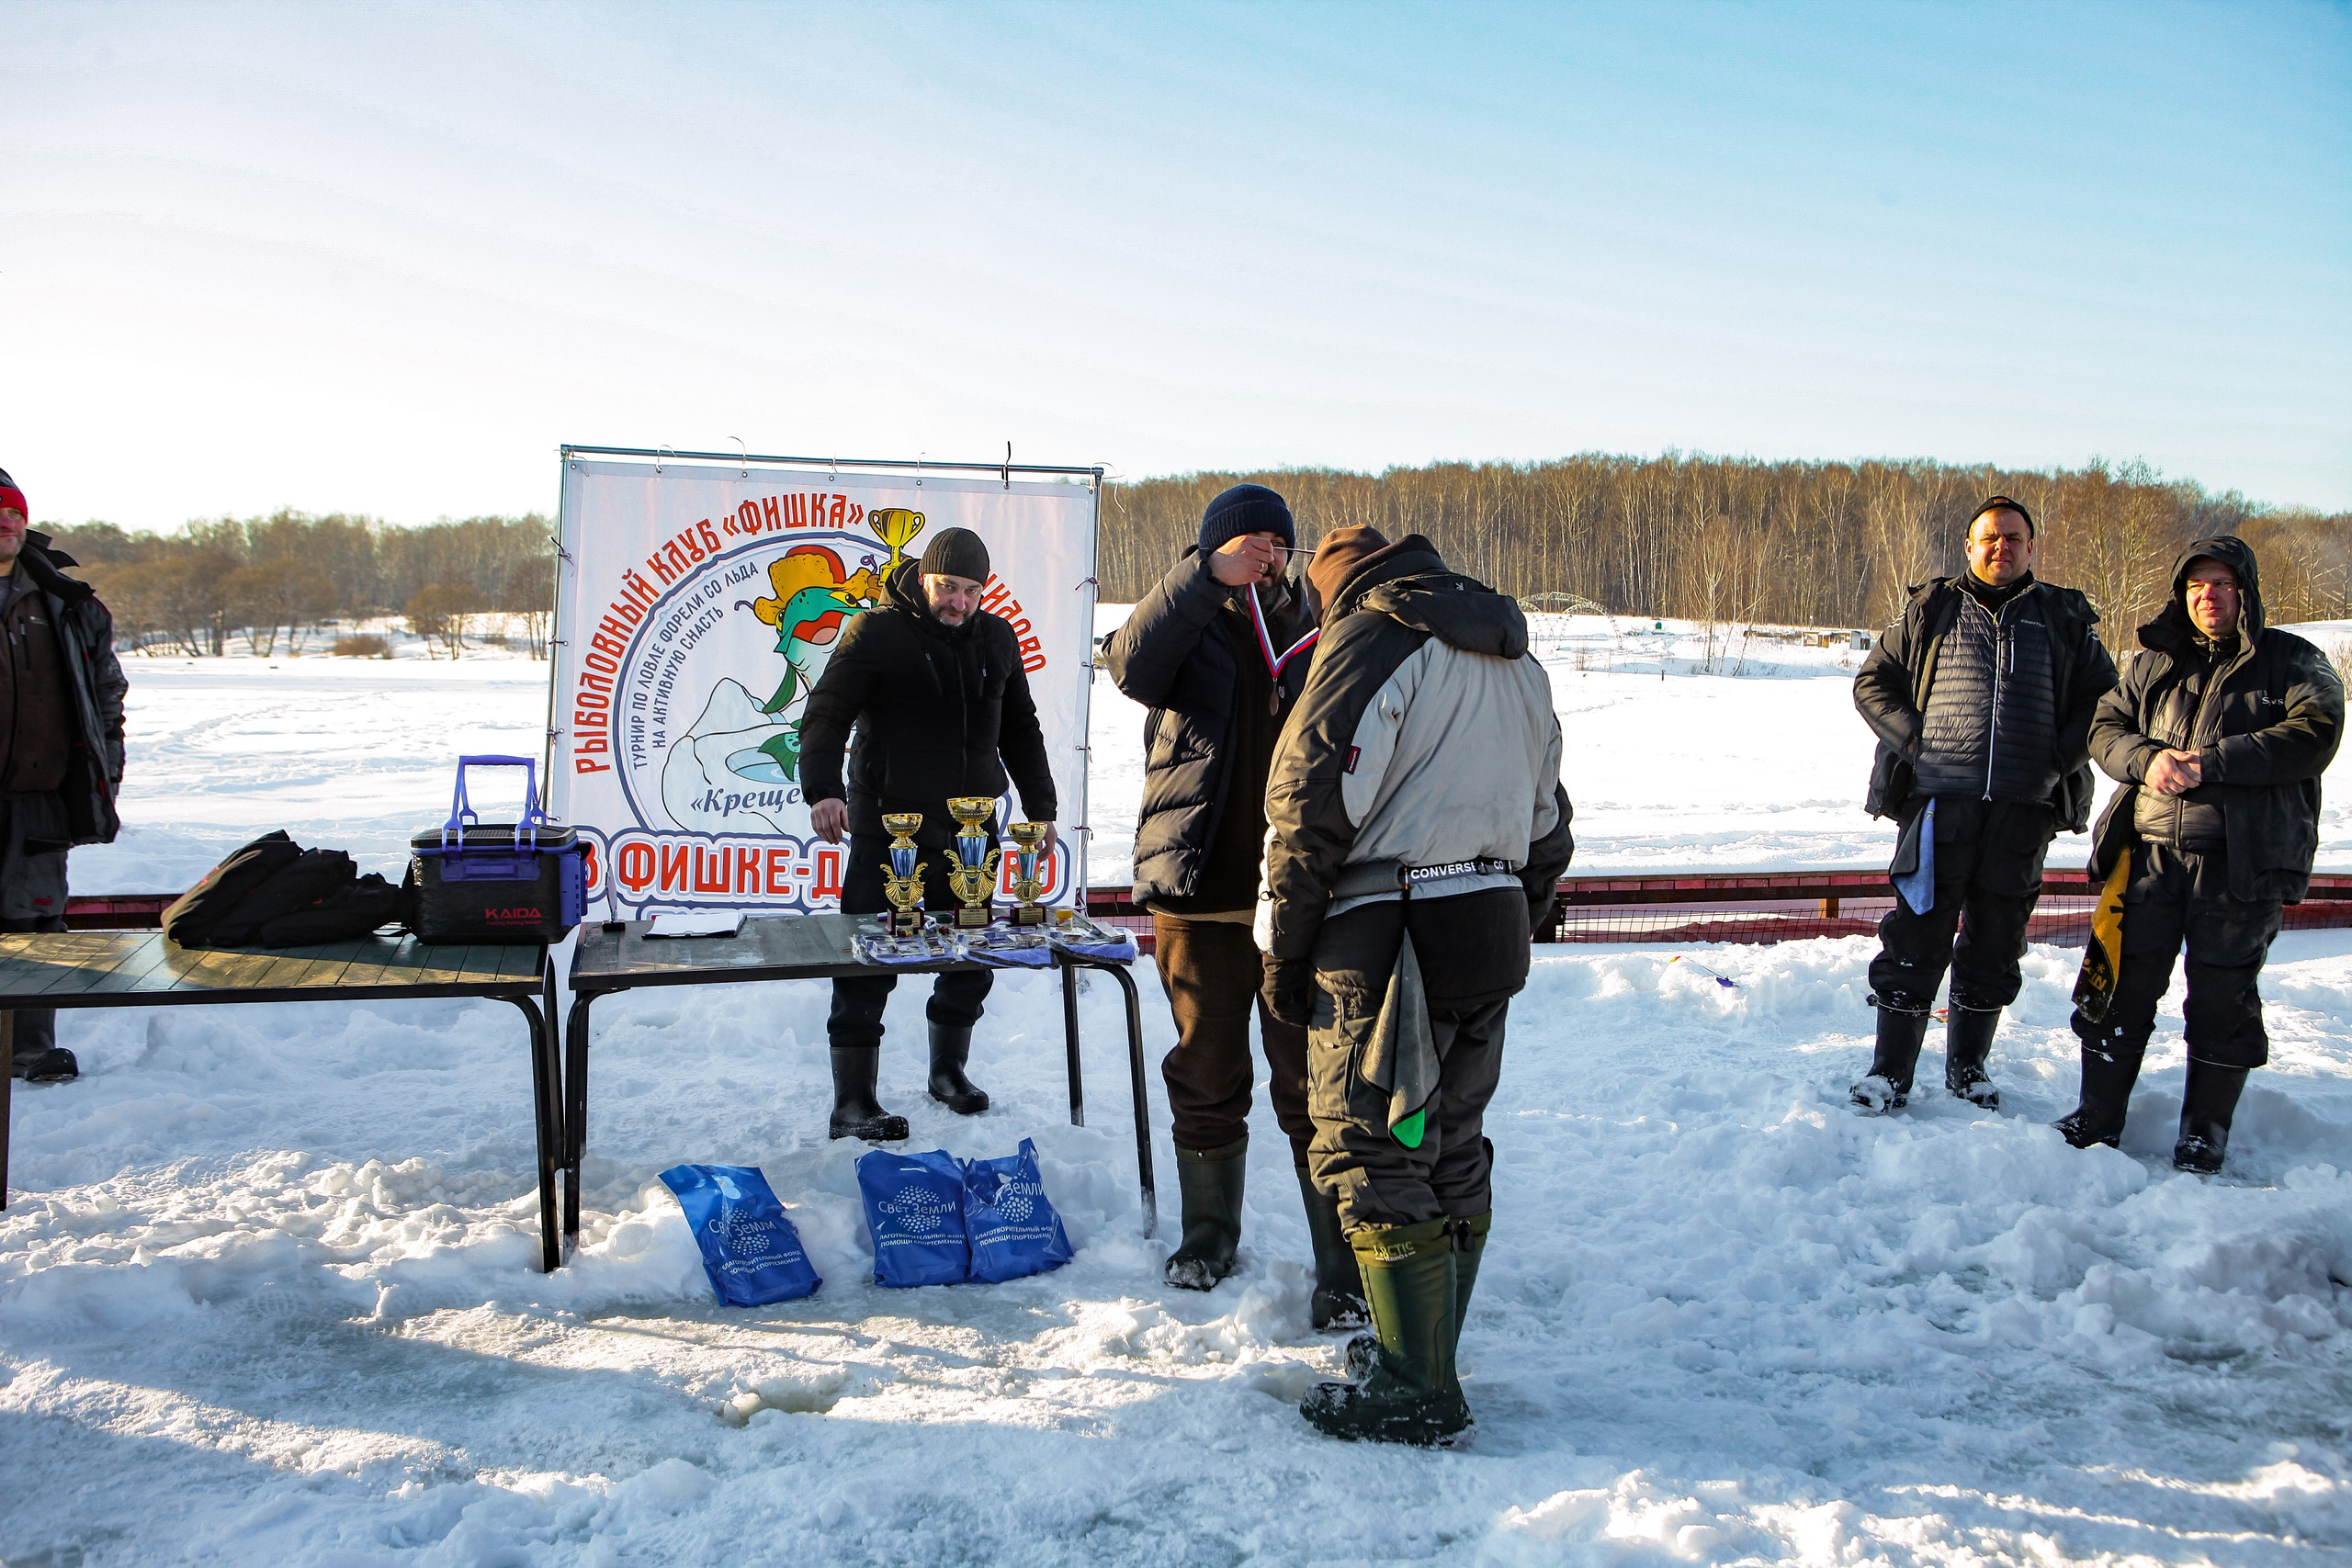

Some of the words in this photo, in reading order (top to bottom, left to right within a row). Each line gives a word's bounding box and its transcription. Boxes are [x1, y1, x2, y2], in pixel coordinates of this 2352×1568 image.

[724, 561, 759, 588] ЛЬДА
[703, 579, 723, 599] СО
[659, 592, 706, 643] ФОРЕЛИ
[573, 568, 660, 774] РЫБОЛОВНЫЙ
[646, 518, 722, 586] КЛУБ
[722, 492, 865, 536] «ФИШКА»
[980, 569, 1046, 674] ИЛОВО
[679, 606, 724, 650] СНАСТЬ
[637, 643, 666, 690] ЛОВЛЕ
[652, 649, 687, 726] АКТИВНУЮ
[631, 692, 649, 711] ПО
[630, 715, 648, 771] ТУРНИР
[652, 732, 666, 749] НА
[690, 787, 807, 818] «Креще
[1410, 862, 1477, 880] CONVERSE
[485, 908, 542, 919] KAIDA
[878, 1201, 910, 1214] Свет
[911, 1201, 956, 1215] Земли
[730, 1221, 777, 1237] Земли
[878, 1233, 946, 1241] ЛАГОТВОРИТЕЛЬНЫЙ
[880, 1238, 913, 1248] ПОМОЩИ
[979, 1235, 1012, 1247] ПОМОЩИ
